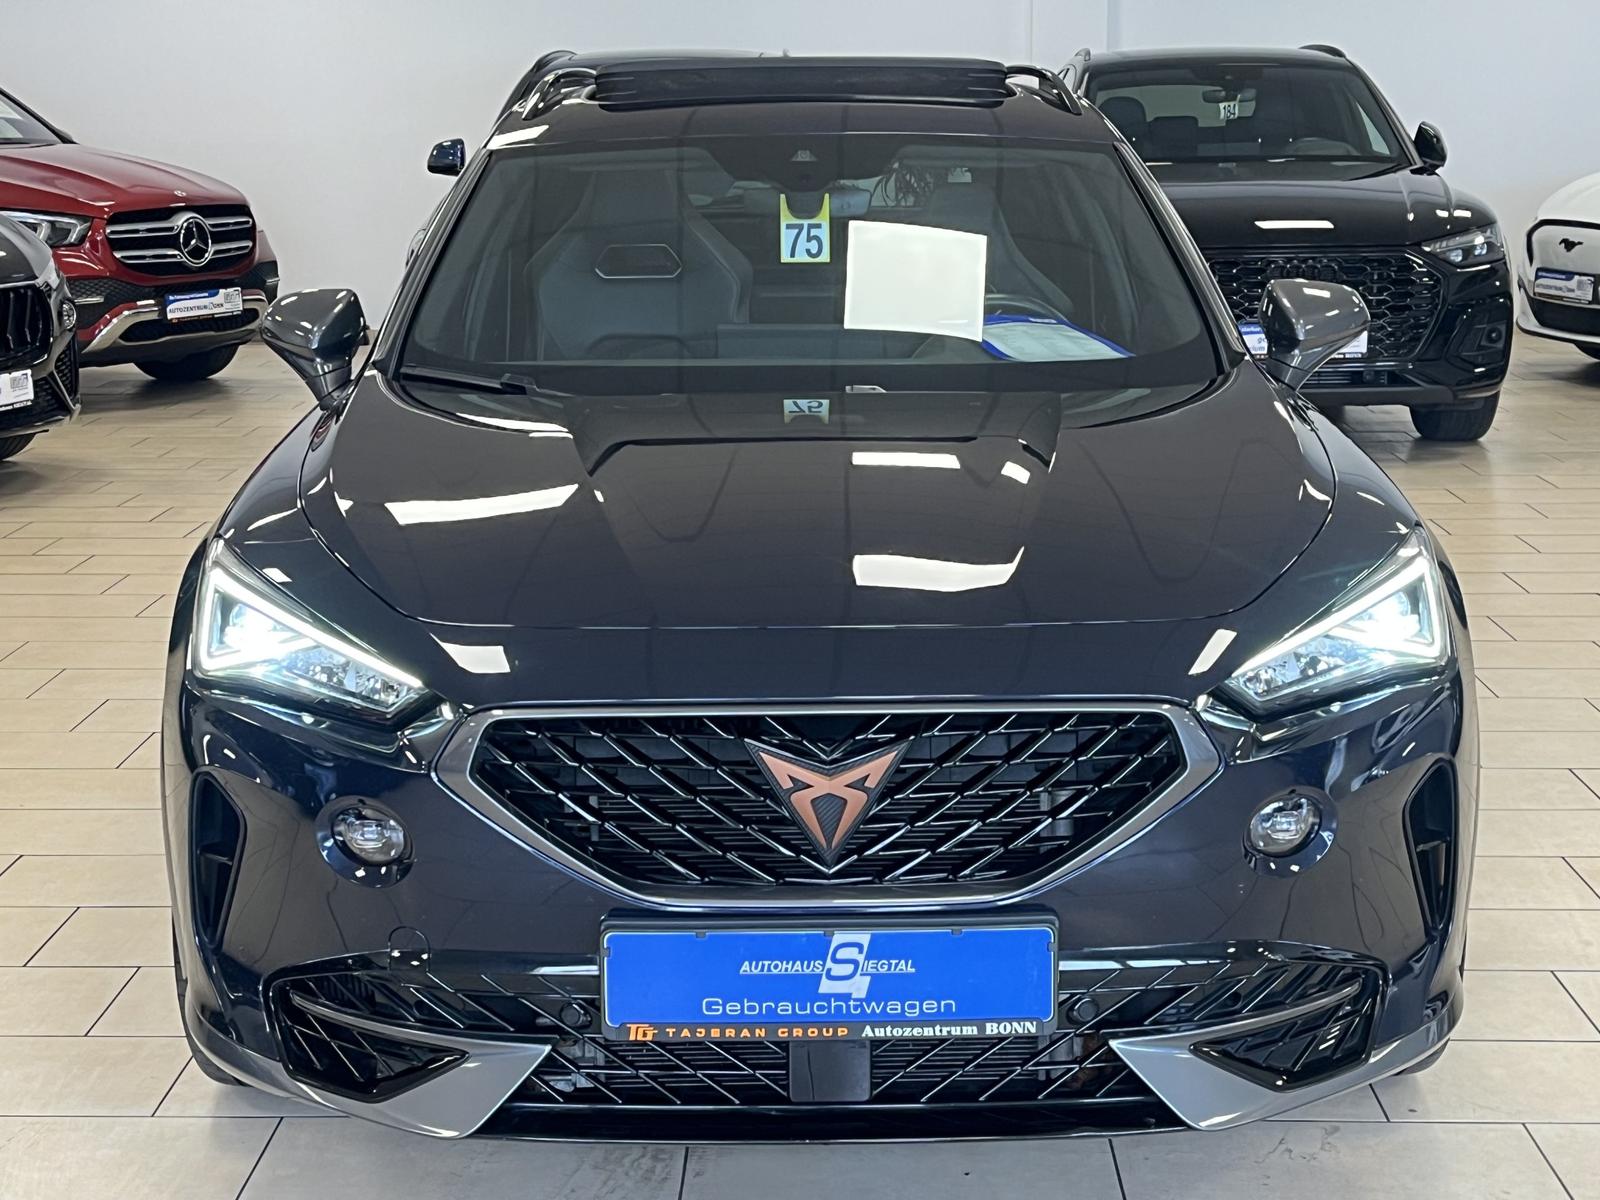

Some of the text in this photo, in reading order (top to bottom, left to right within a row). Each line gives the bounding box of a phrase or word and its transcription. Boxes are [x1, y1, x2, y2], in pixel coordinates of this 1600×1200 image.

[785, 223, 823, 258] 75
[739, 960, 824, 974] AUTOHAUS
[702, 998, 956, 1016] Gebrauchtwagen
[665, 1028, 766, 1038] TAJERAN
[777, 1027, 849, 1037] GROUP
[861, 1025, 978, 1037] Autozentrum
[985, 1021, 1037, 1035] BONN
